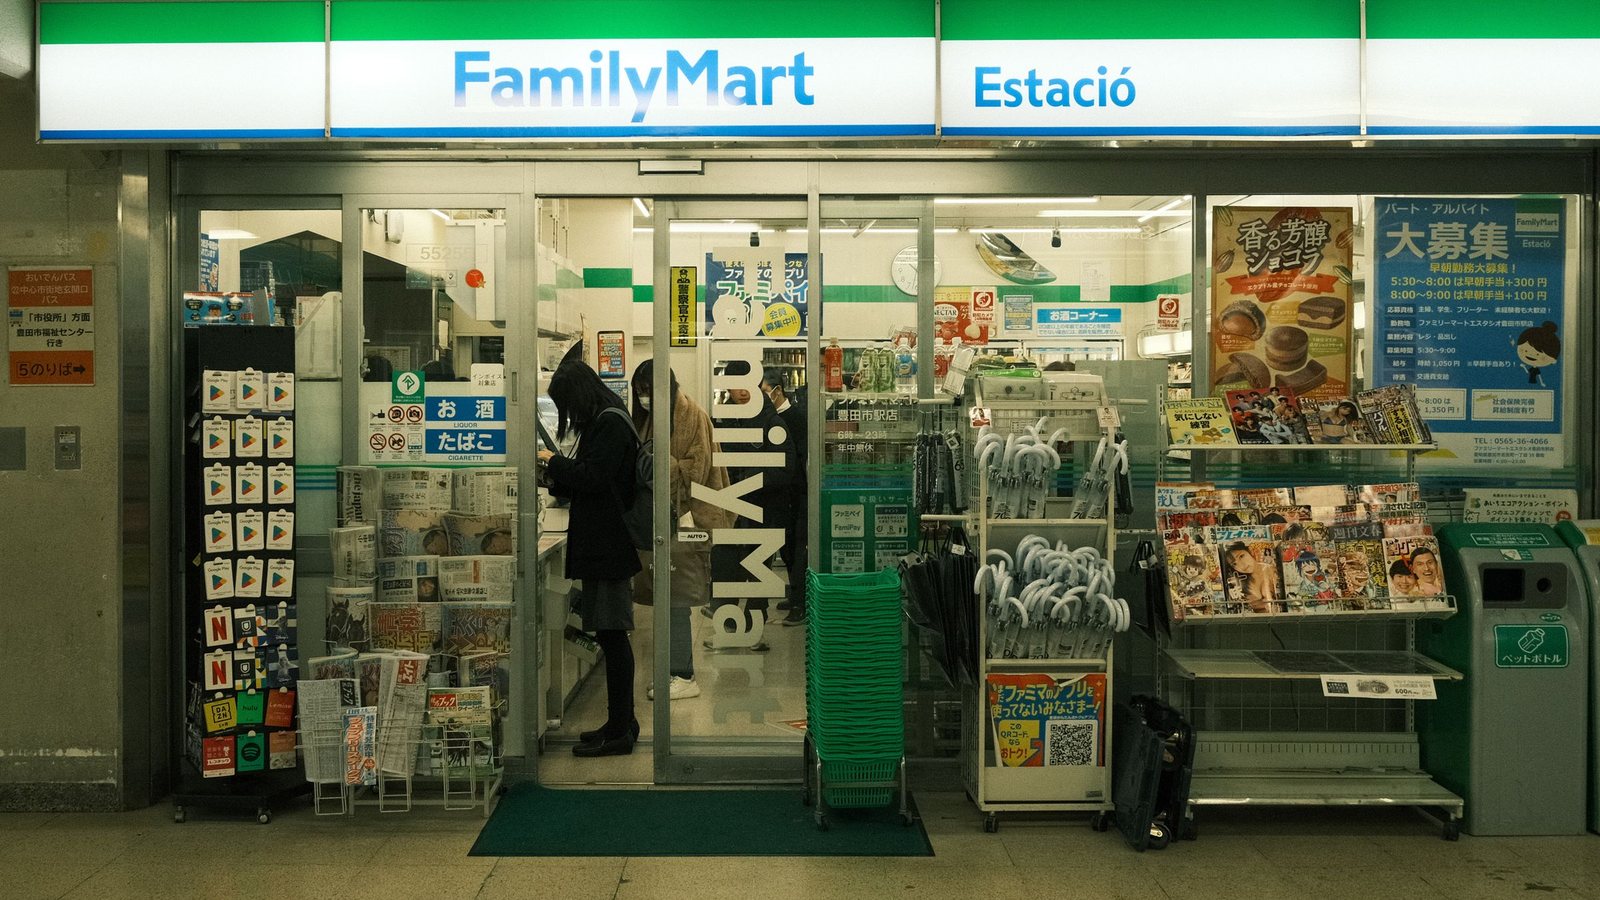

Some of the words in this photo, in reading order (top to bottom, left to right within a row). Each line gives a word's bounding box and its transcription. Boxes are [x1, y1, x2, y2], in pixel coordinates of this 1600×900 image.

[454, 50, 814, 123] FamilyMart
[976, 66, 1136, 109] Estació
[1385, 204, 1489, 214] パート・アルバイト
[1516, 218, 1558, 227] FamilyMart
[1238, 218, 1329, 251] 香る芳醇
[1385, 222, 1509, 260] 大募集
[1522, 239, 1551, 248] Estació
[1247, 250, 1321, 275] ショコラ
[25, 273, 76, 281] おいでんバス
[42, 296, 58, 304] バス
[1050, 311, 1108, 321] お酒コーナー
[17, 328, 93, 337] 豊田市福祉センター
[47, 339, 63, 347] 行き
[837, 405, 898, 417] 豊田市駅店
[1174, 413, 1222, 421] 気にしない
[1190, 421, 1210, 429] 練習
[438, 433, 494, 451] たばこ
[838, 443, 874, 453] 年中無休
[1333, 525, 1382, 539] 週刊文春
[1502, 654, 1562, 663] ペットボトル
